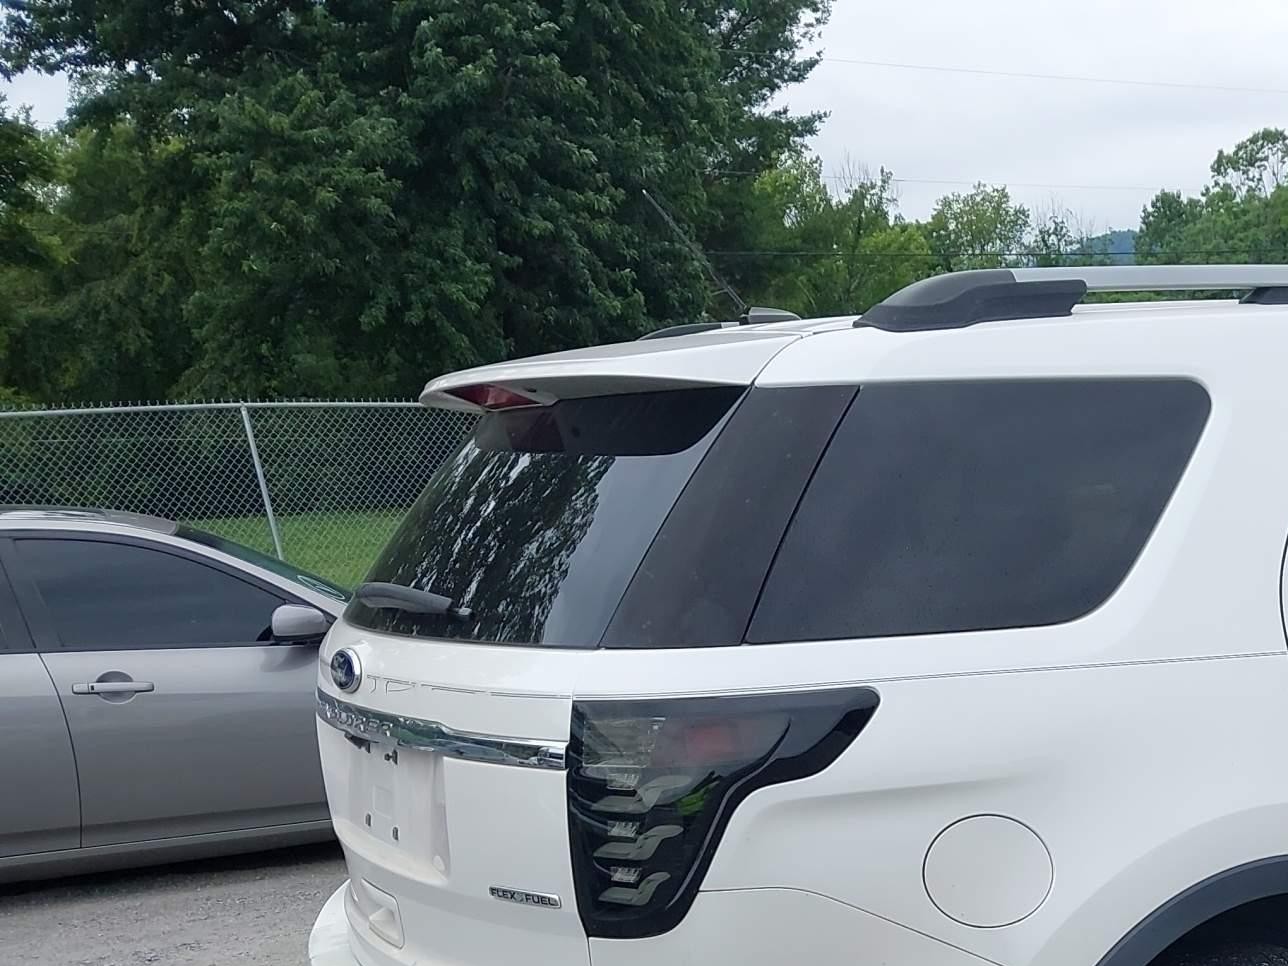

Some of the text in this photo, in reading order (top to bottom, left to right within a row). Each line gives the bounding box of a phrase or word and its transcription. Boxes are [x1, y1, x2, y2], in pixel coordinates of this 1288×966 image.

[319, 701, 395, 737] LORER
[490, 887, 557, 906] FLEX FUEL
